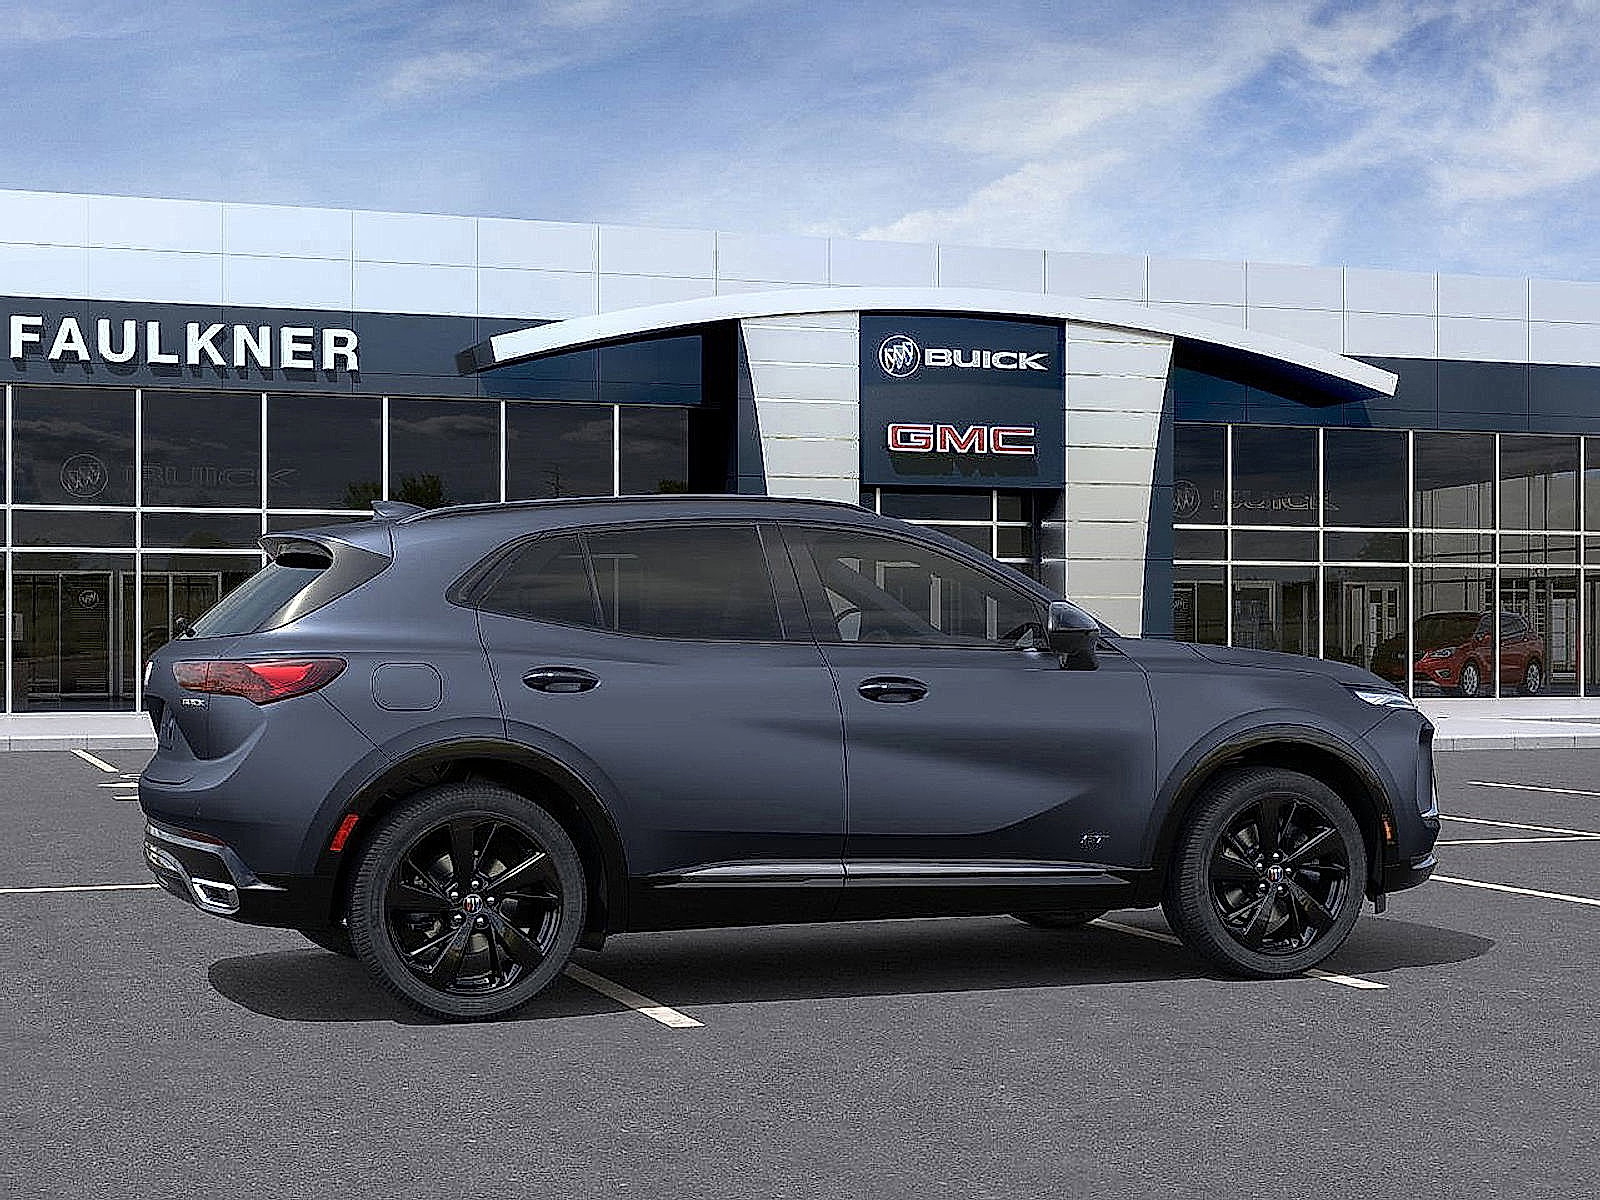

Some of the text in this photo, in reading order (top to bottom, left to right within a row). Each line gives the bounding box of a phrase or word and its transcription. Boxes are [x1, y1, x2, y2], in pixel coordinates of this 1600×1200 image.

[9, 314, 358, 371] FAULKNER
[924, 348, 1049, 371] BUICK
[888, 423, 1035, 455] GMC
